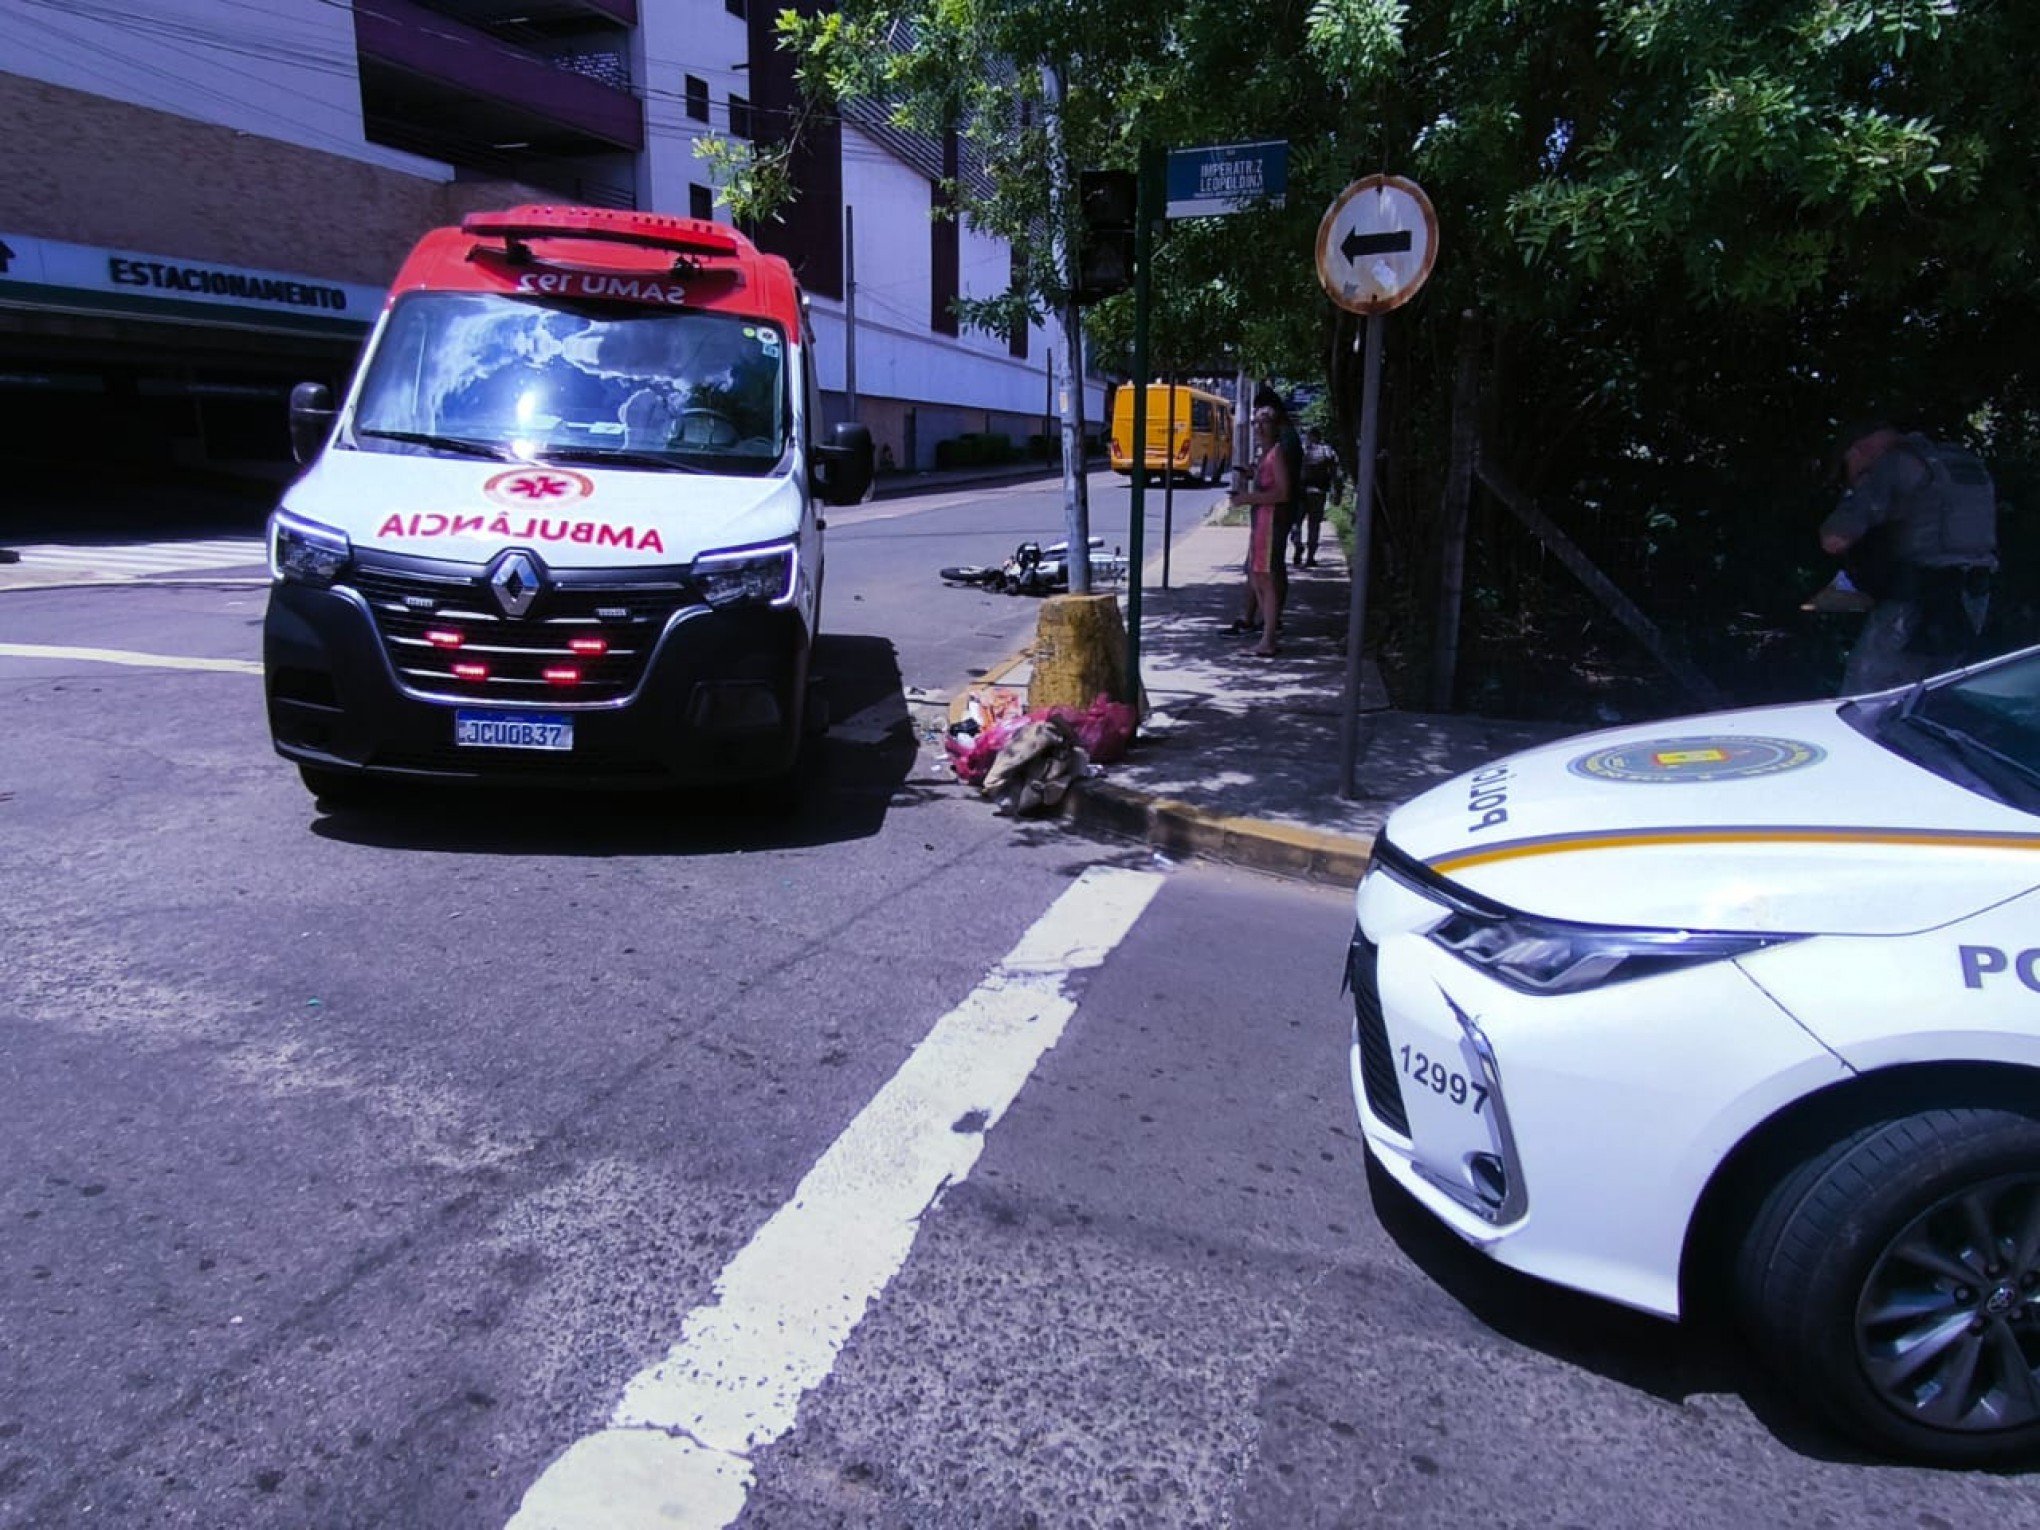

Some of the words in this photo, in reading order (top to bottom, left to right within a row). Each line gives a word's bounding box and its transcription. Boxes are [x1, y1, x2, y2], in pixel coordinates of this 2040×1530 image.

[1201, 159, 1262, 178] IMPERATRZ
[109, 257, 347, 310] ESTACIONAMENTO
[1401, 1044, 1488, 1114] 12997
